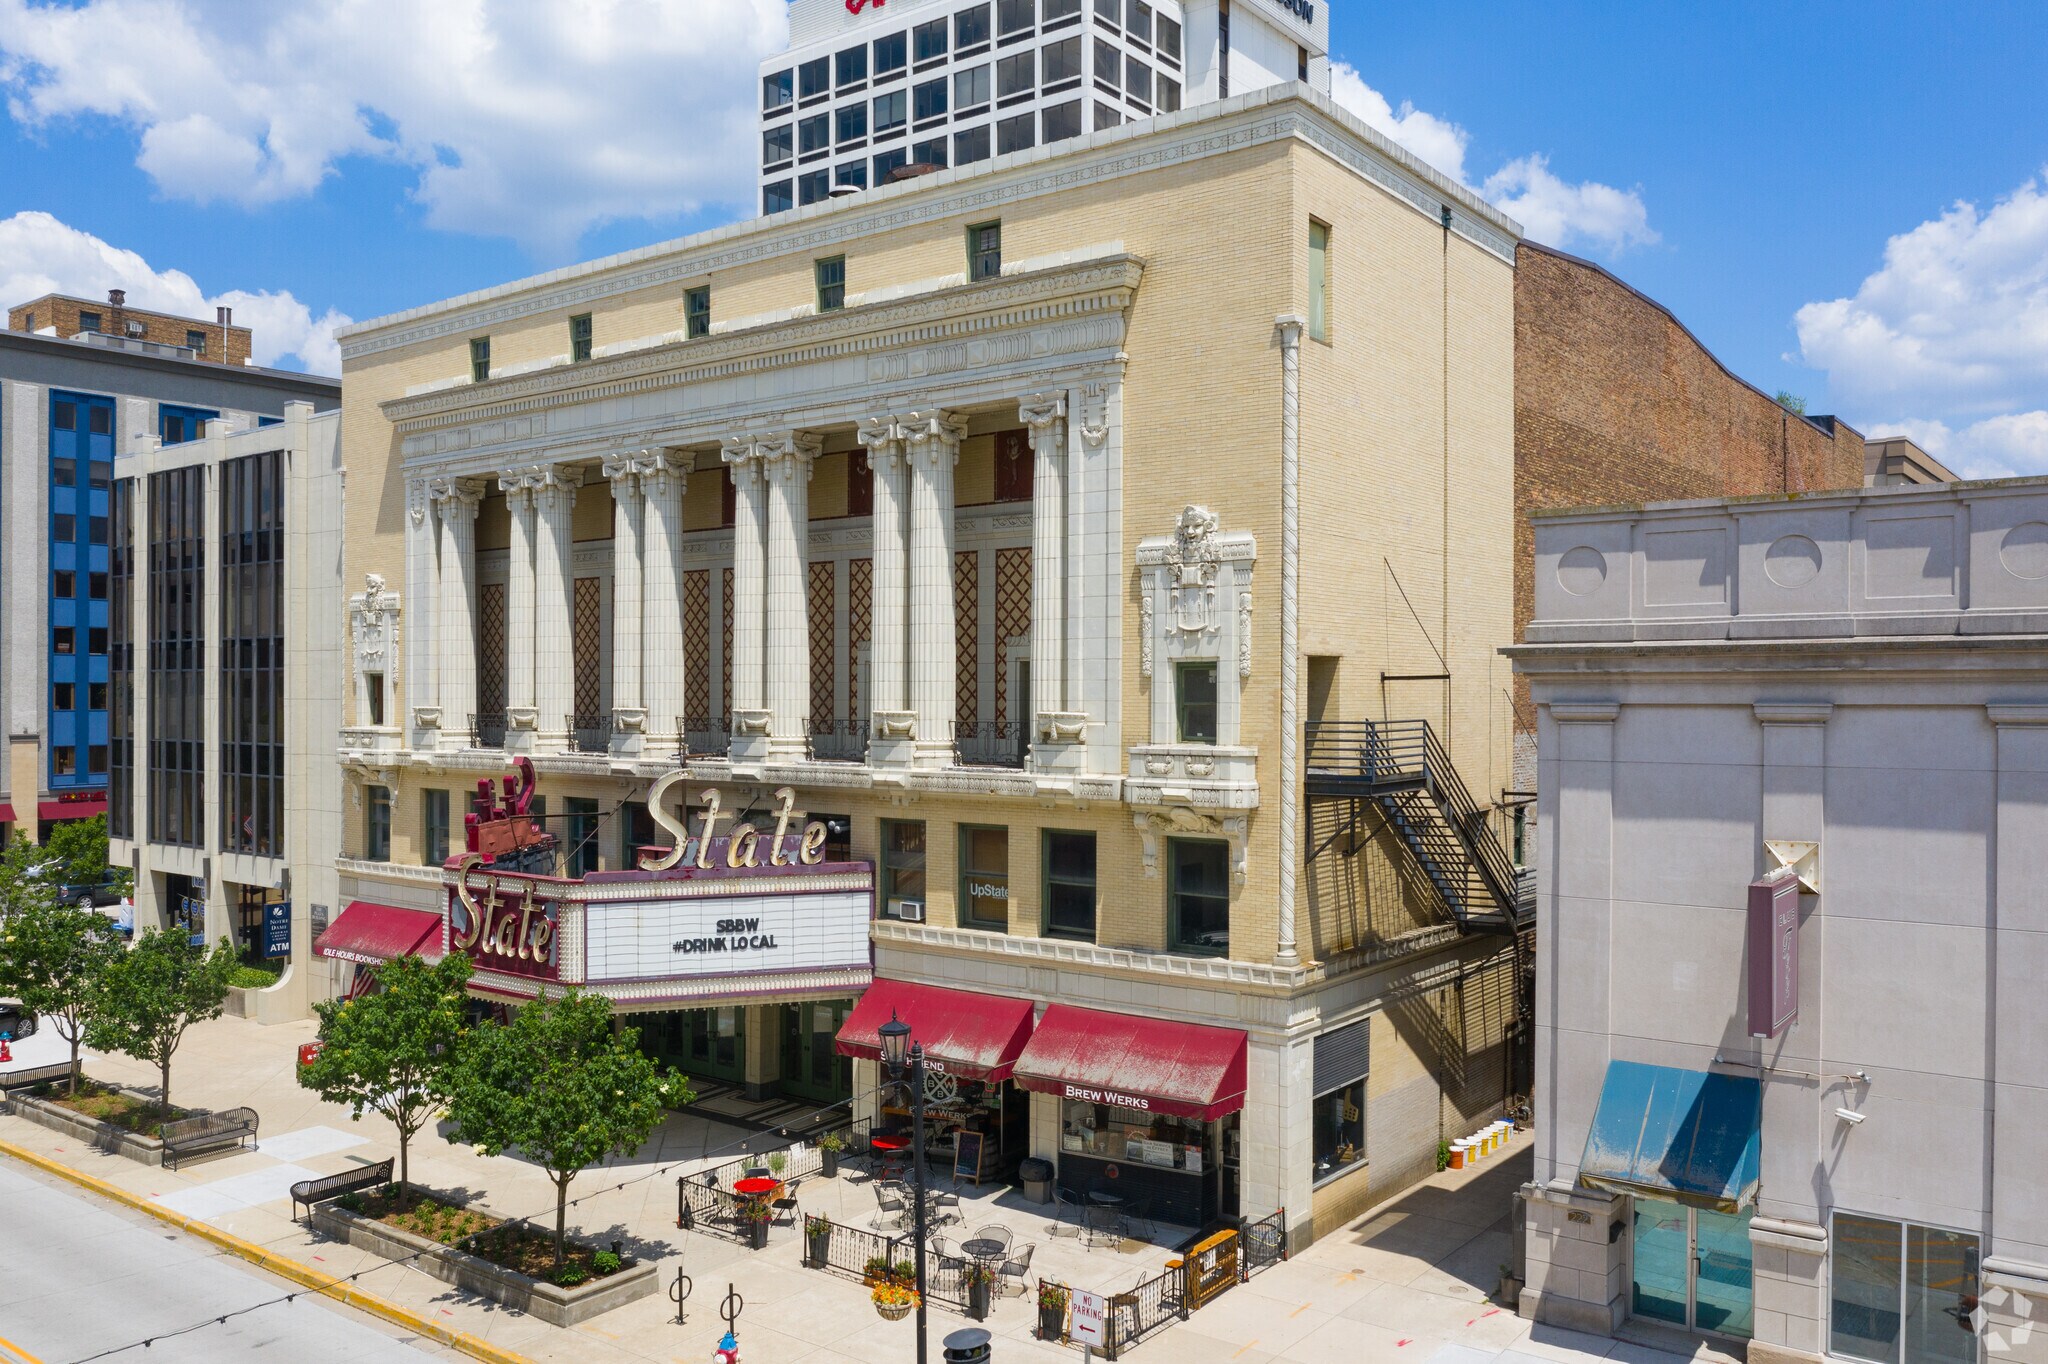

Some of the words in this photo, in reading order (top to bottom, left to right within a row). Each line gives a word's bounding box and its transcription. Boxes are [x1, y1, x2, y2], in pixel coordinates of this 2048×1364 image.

[638, 767, 828, 871] State
[454, 853, 554, 963] State
[716, 917, 759, 933] SBBW
[269, 942, 290, 953] ATM
[673, 937, 728, 954] #DRINK
[323, 948, 336, 957] IDLE
[336, 950, 356, 961] HOURS
[354, 953, 384, 966] BOOKSHO
[921, 1060, 945, 1072] END
[1065, 1085, 1102, 1101] BREW
[1104, 1091, 1149, 1109] WERKS
[1083, 1295, 1093, 1307] NO
[1073, 1303, 1102, 1321] PARKING
